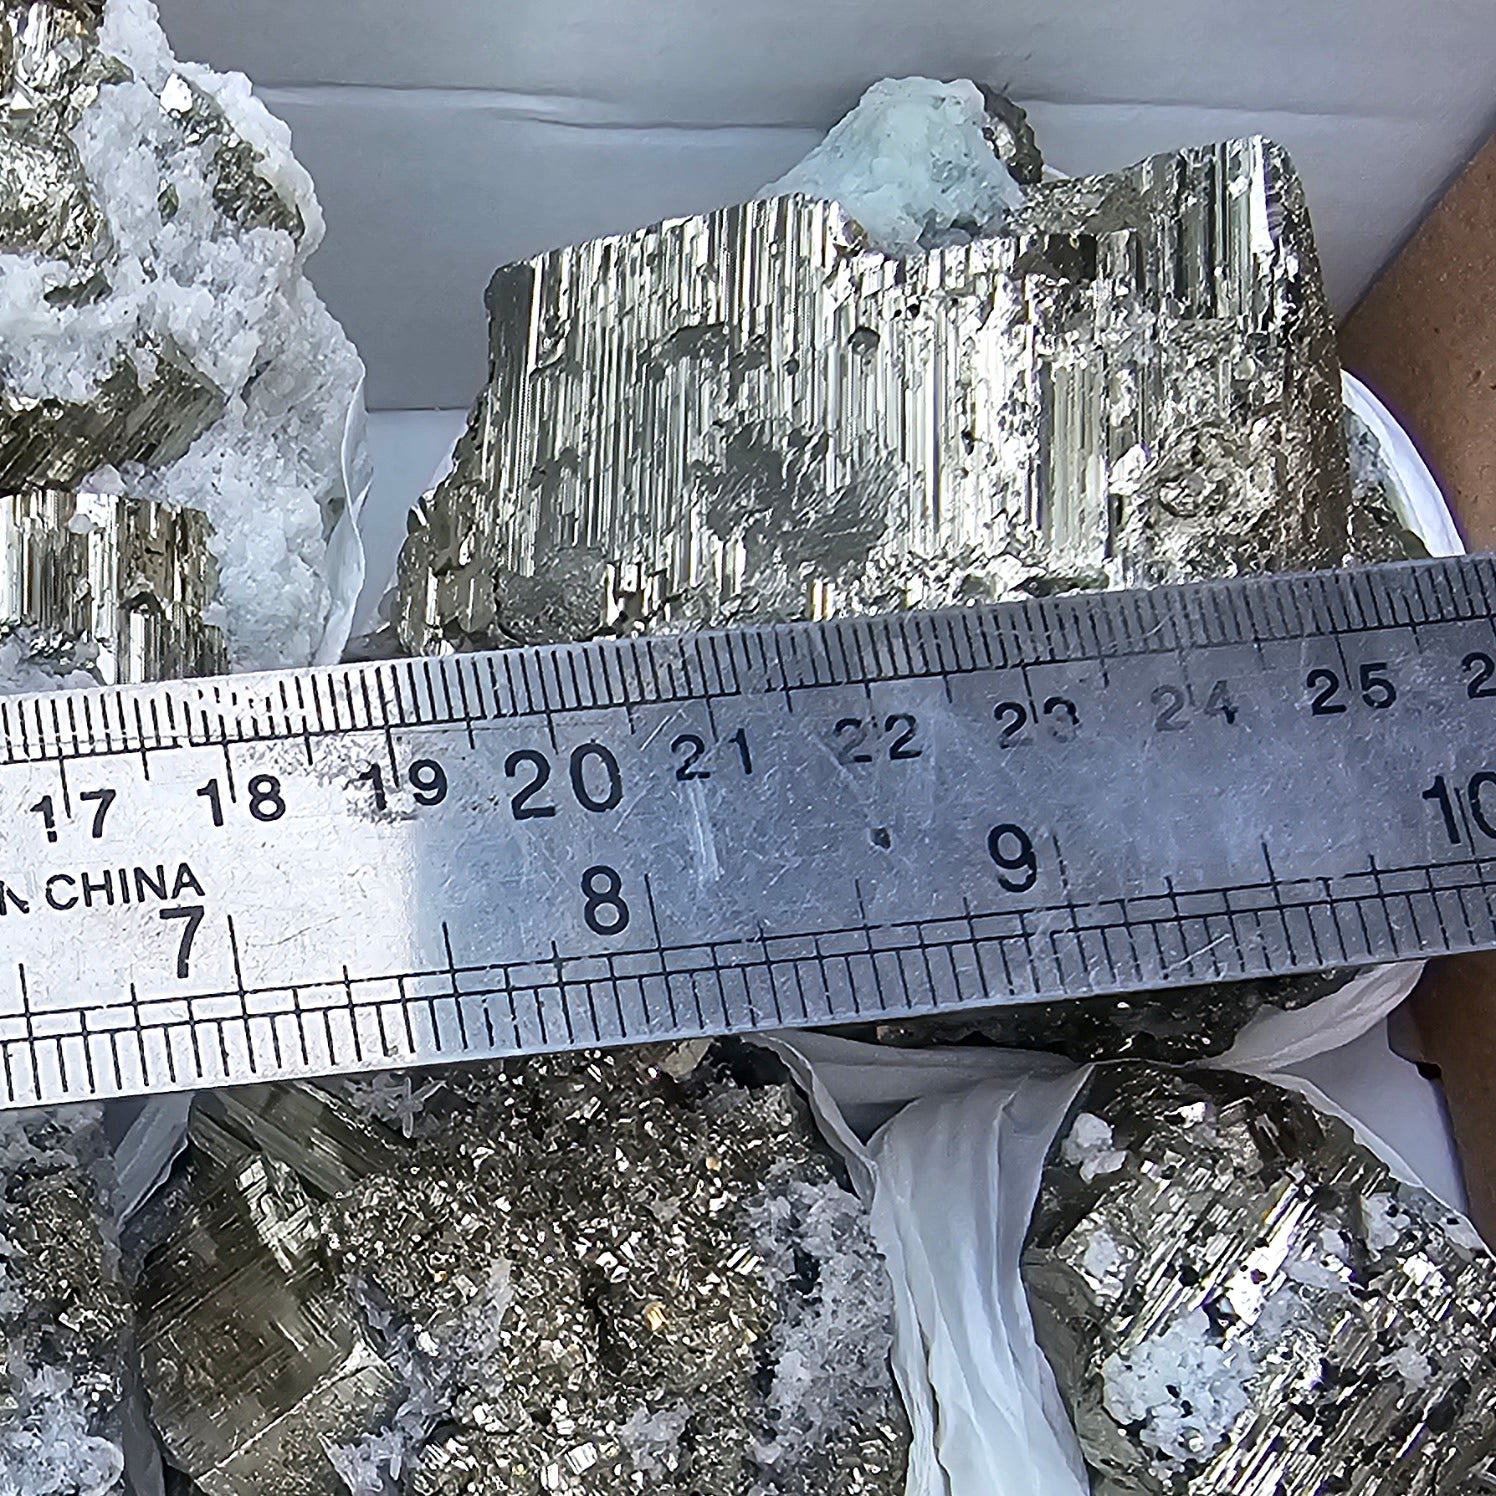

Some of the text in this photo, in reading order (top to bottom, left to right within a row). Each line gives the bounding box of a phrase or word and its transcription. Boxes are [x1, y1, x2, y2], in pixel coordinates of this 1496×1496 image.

[31, 789, 116, 842] 17
[197, 775, 286, 826] 18
[361, 758, 448, 810] 19
[505, 743, 622, 820] 20
[671, 728, 753, 781] 21
[834, 713, 922, 763] 22
[994, 696, 1080, 749] 23
[1151, 681, 1238, 731] 24
[1307, 663, 1397, 715] 25
[45, 862, 205, 911] CHINA
[159, 905, 204, 978] 7
[581, 865, 629, 935] 8
[988, 823, 1038, 893] 9
